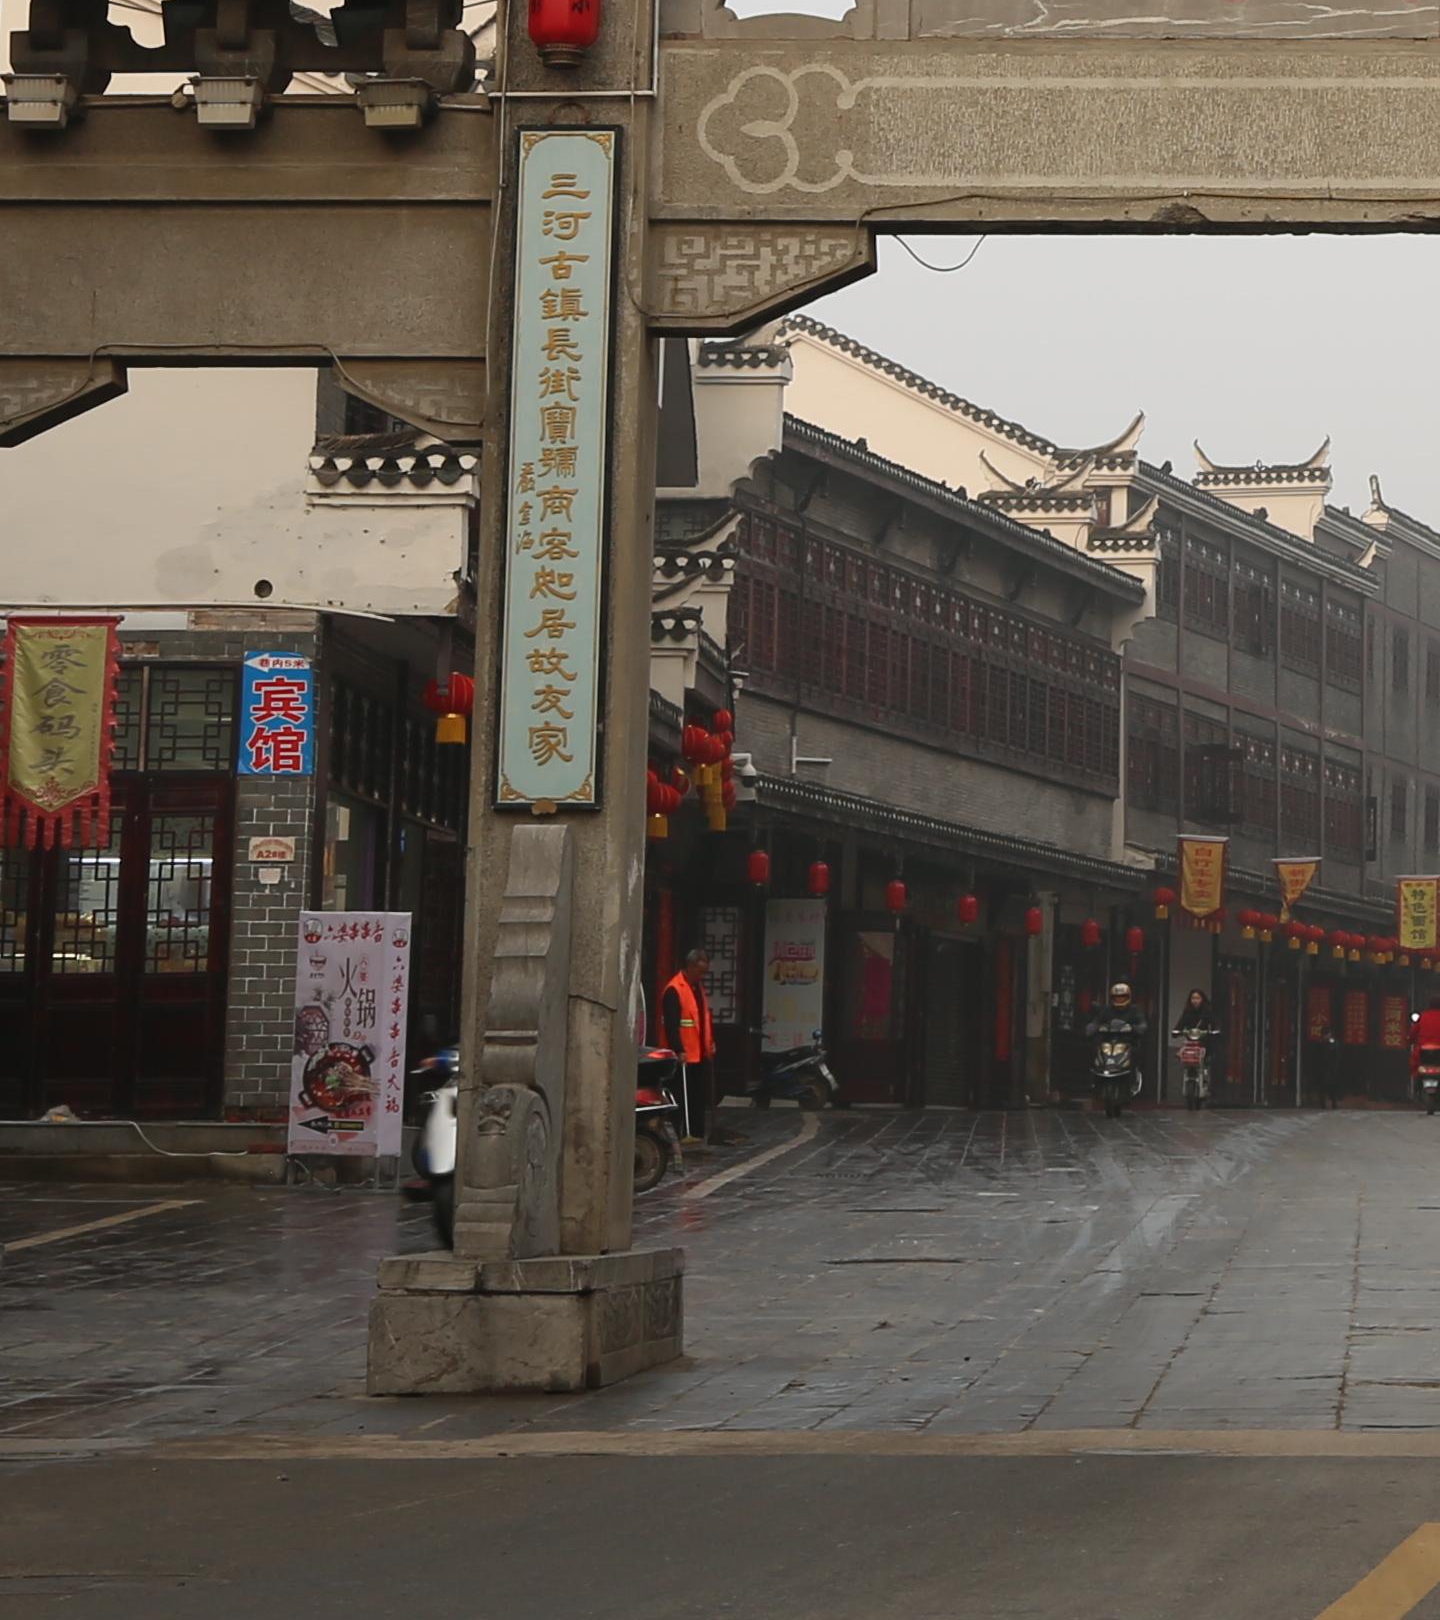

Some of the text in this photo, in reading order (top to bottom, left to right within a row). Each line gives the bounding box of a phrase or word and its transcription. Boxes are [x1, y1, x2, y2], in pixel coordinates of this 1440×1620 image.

[29, 644, 88, 775] 零食码头
[246, 676, 308, 772] 宾馆
[1411, 889, 1427, 940] 特色面馆
